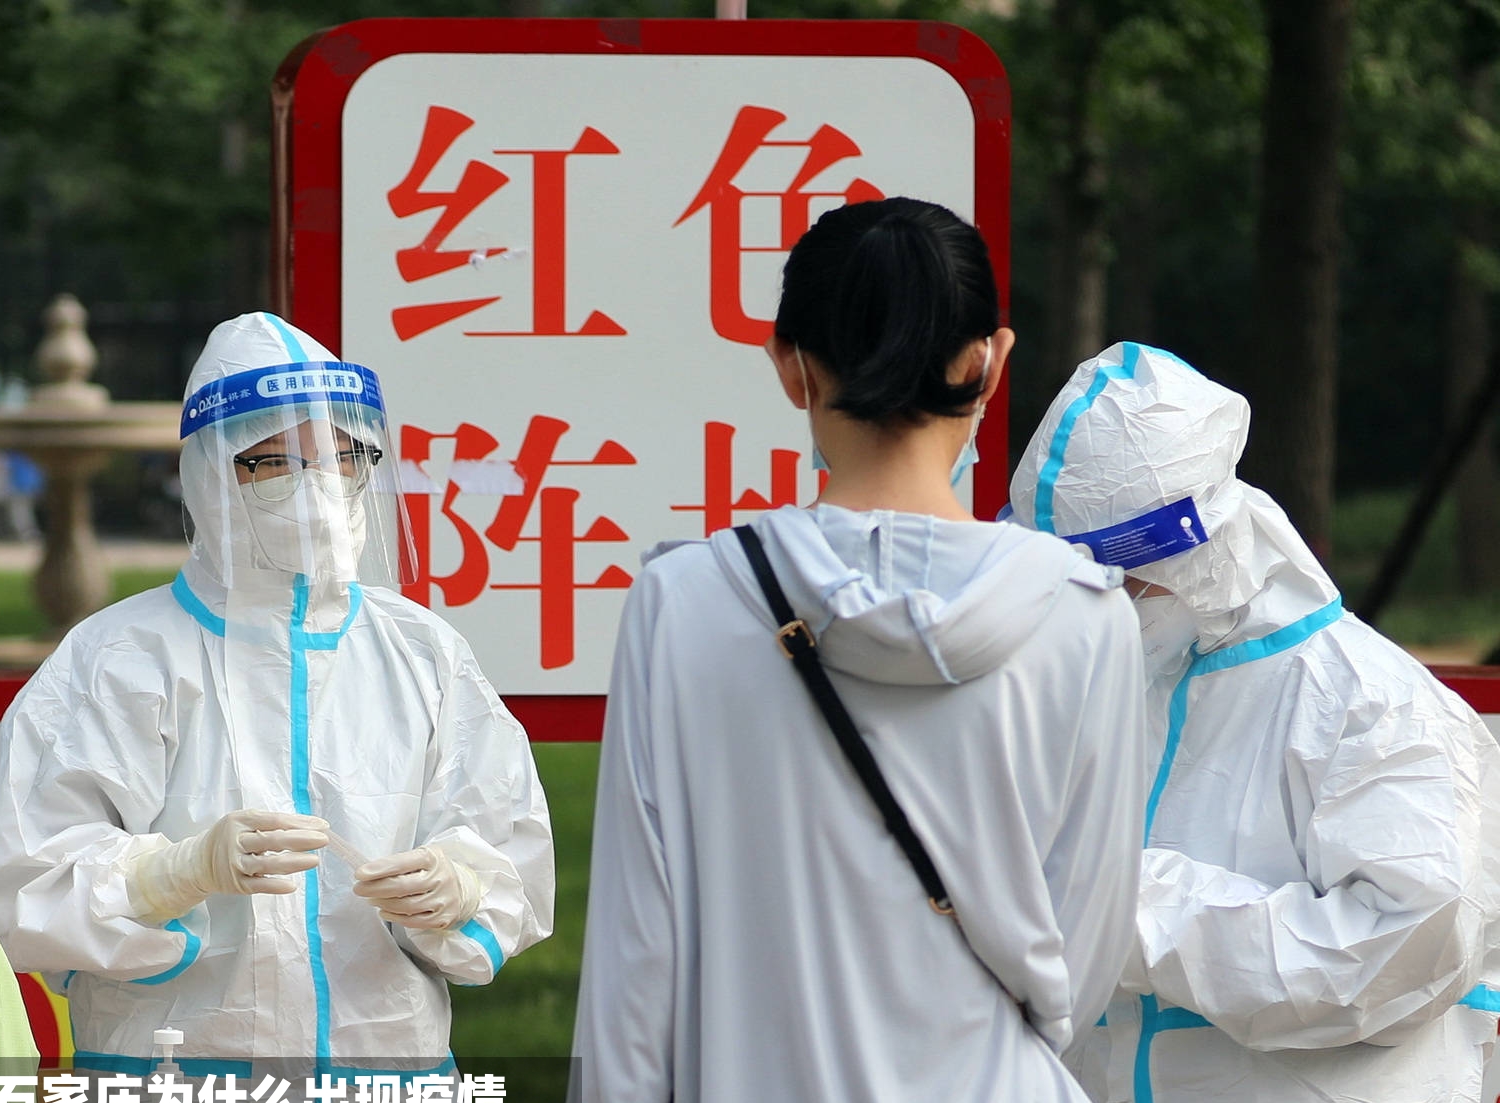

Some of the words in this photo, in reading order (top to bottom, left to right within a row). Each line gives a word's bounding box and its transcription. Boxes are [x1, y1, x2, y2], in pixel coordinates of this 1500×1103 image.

[266, 374, 357, 393] 医用隔离面罩
